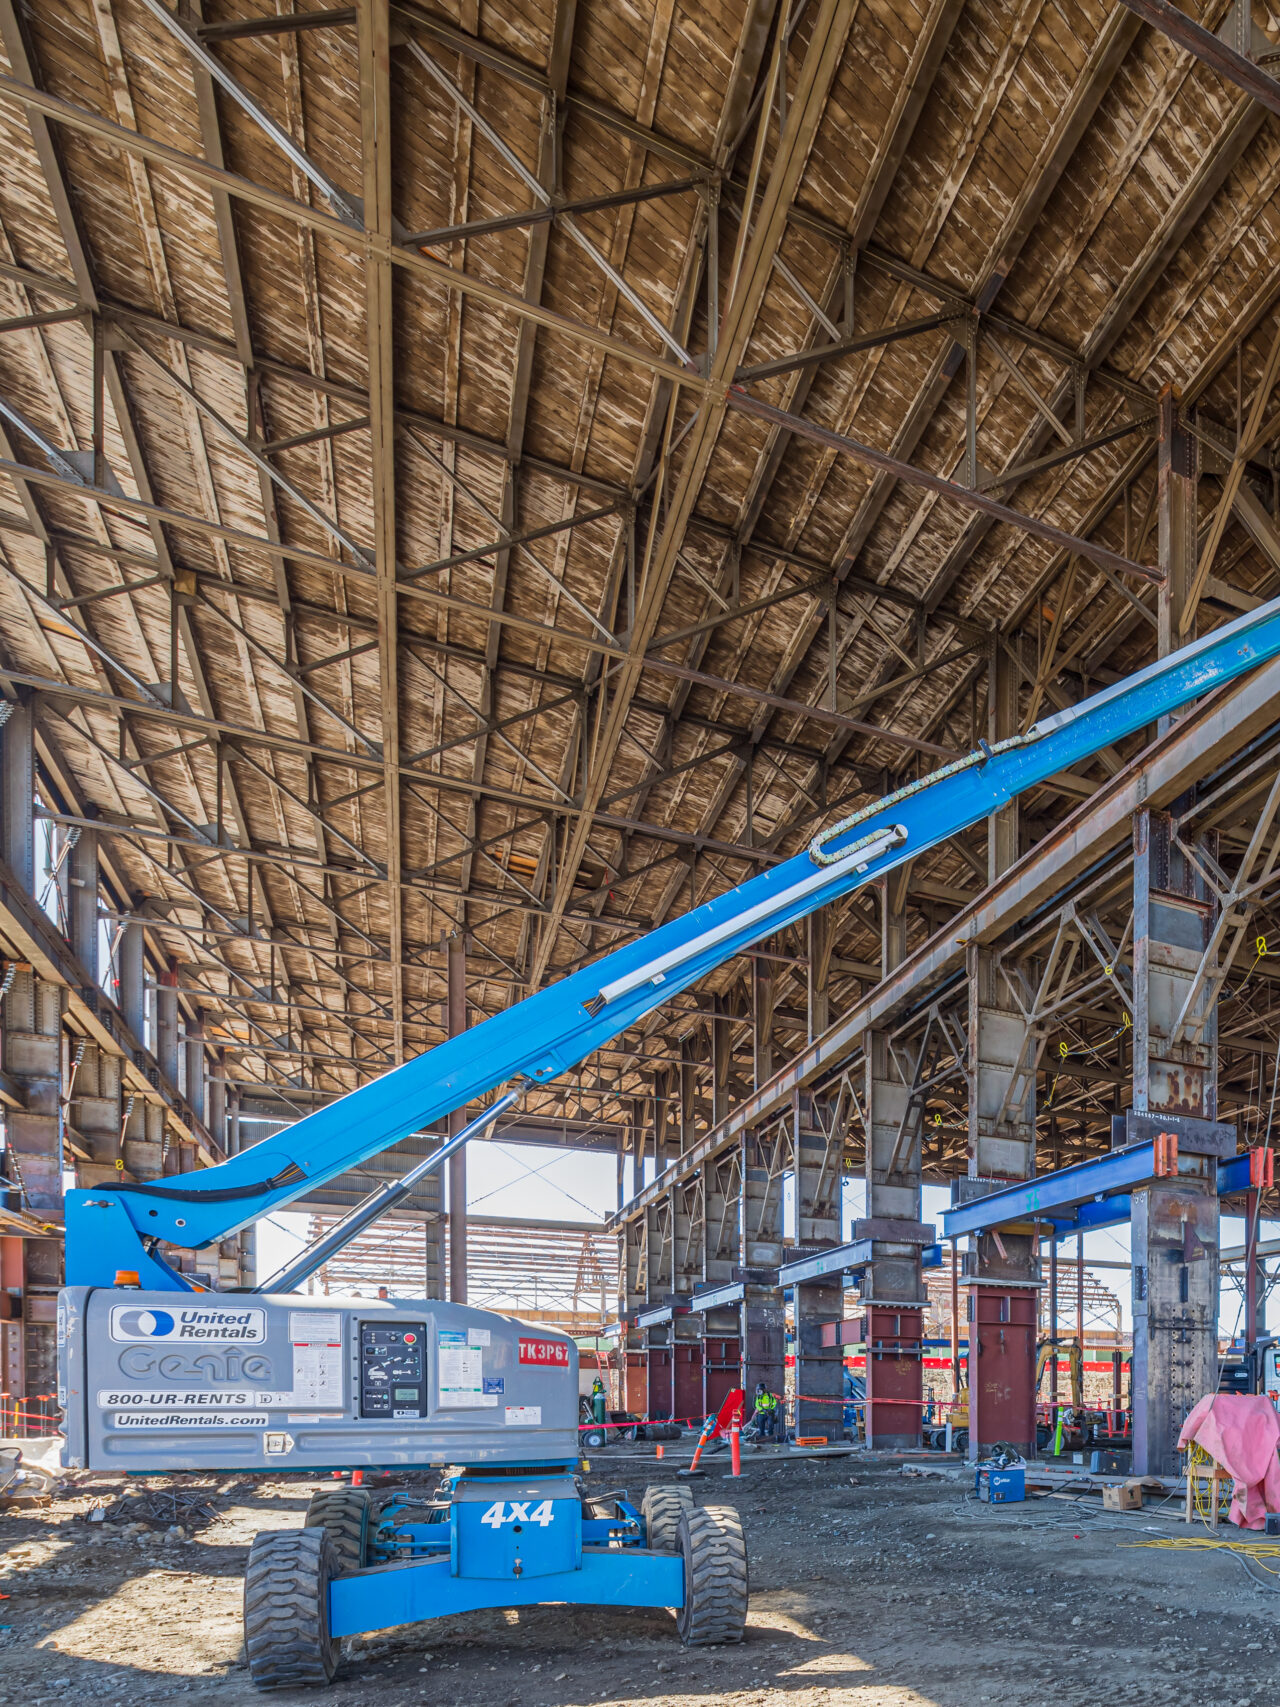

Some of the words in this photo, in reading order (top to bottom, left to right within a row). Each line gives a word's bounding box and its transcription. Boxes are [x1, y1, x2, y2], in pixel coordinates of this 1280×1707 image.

[180, 1311, 251, 1325] United
[180, 1325, 258, 1339] Rentals
[518, 1343, 570, 1362] TK3P67
[118, 1345, 273, 1382] Genie
[106, 1393, 248, 1407] 800-UR-RENTS
[116, 1413, 267, 1428] UnitedRentals.com
